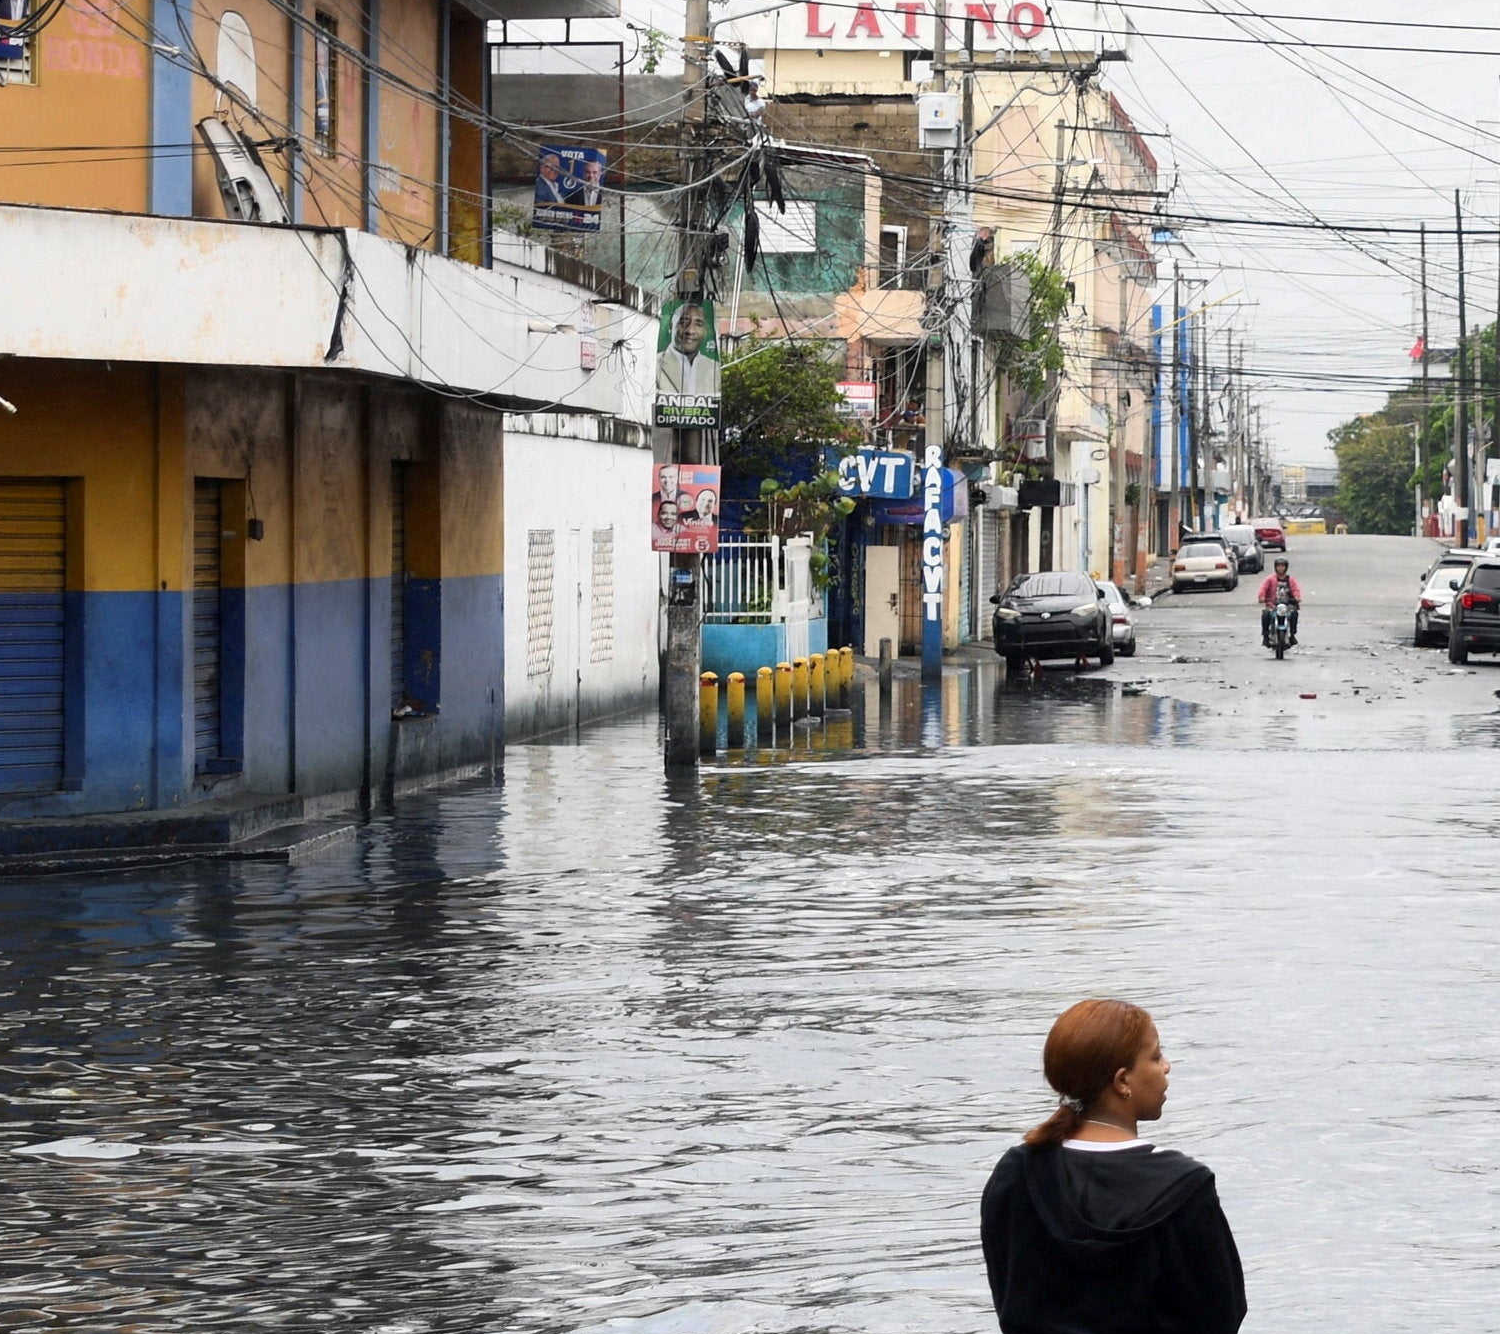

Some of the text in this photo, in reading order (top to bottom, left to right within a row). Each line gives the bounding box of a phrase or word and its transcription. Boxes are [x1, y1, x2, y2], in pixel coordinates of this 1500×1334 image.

[560, 149, 585, 160] VOTA
[663, 406, 711, 417] RIVERA
[657, 415, 716, 426] DIPUTADO
[838, 454, 906, 494] CVT
